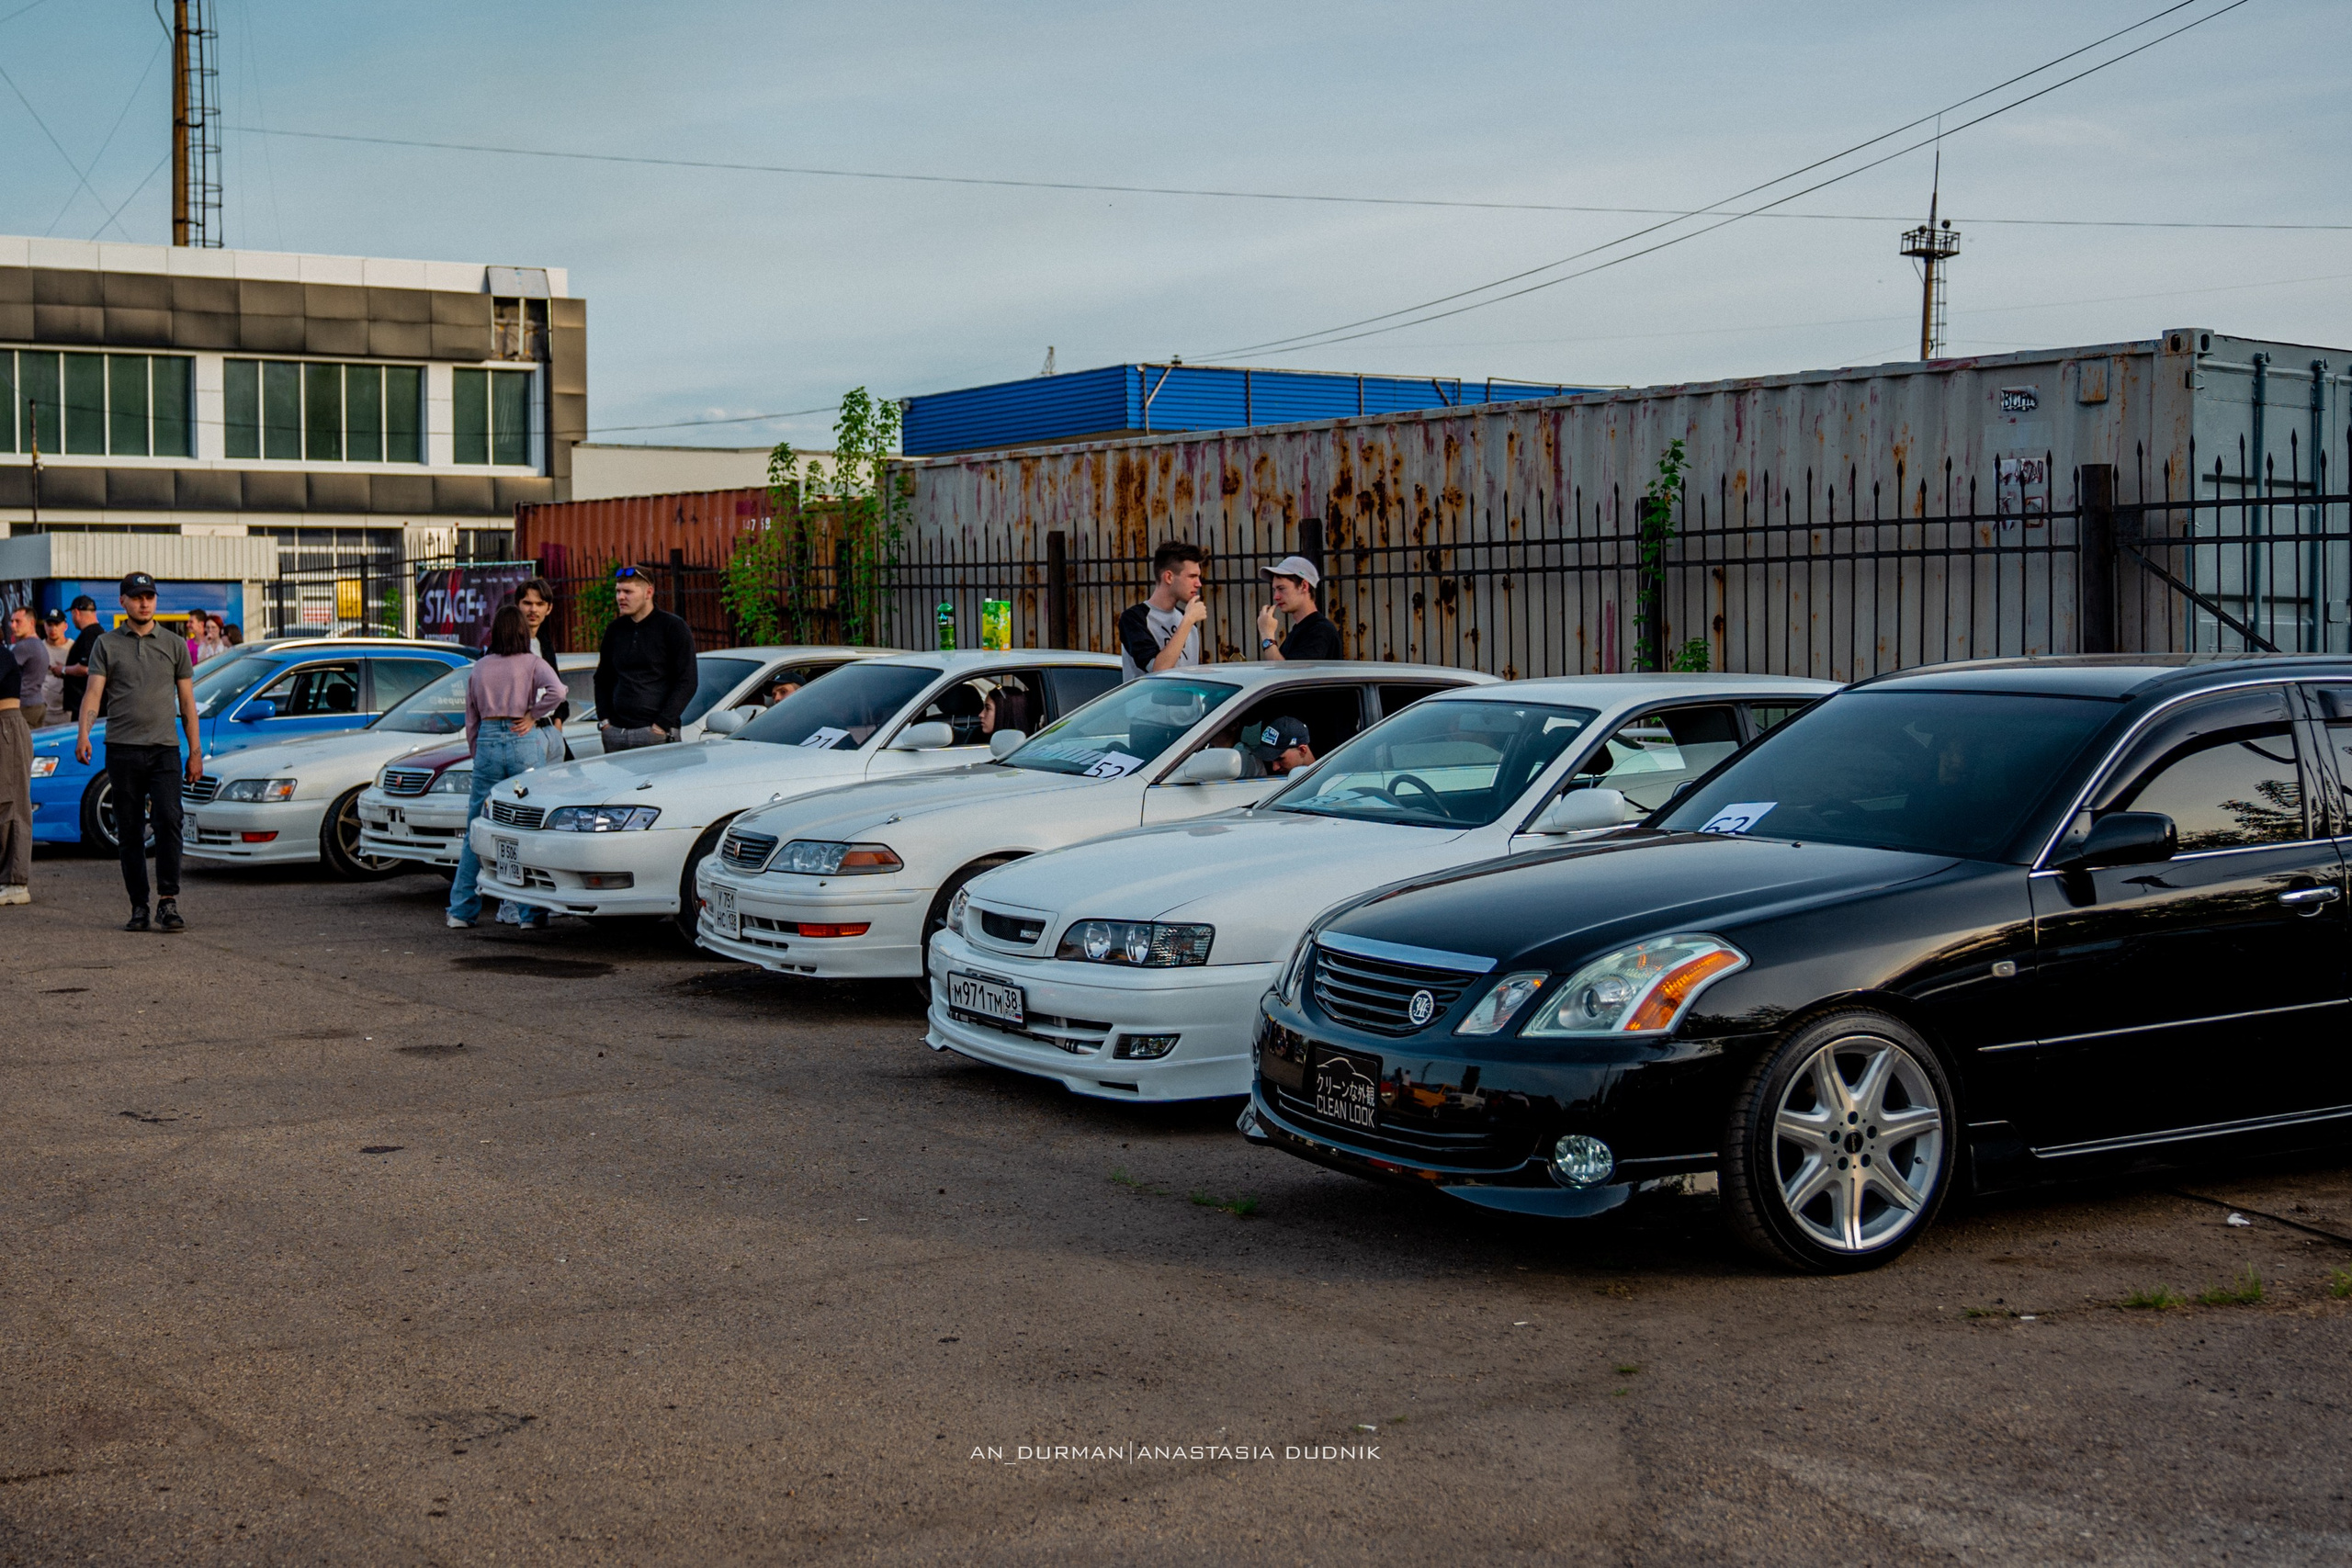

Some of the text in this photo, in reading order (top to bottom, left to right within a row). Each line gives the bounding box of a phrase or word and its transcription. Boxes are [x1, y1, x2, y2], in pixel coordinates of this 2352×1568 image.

[424, 589, 487, 624] STAGE+
[506, 845, 517, 860] 506
[511, 863, 519, 874] 138
[724, 892, 734, 909] 751
[1004, 989, 1017, 1010] 38
[1317, 1094, 1374, 1128] CLEAN LOOK
